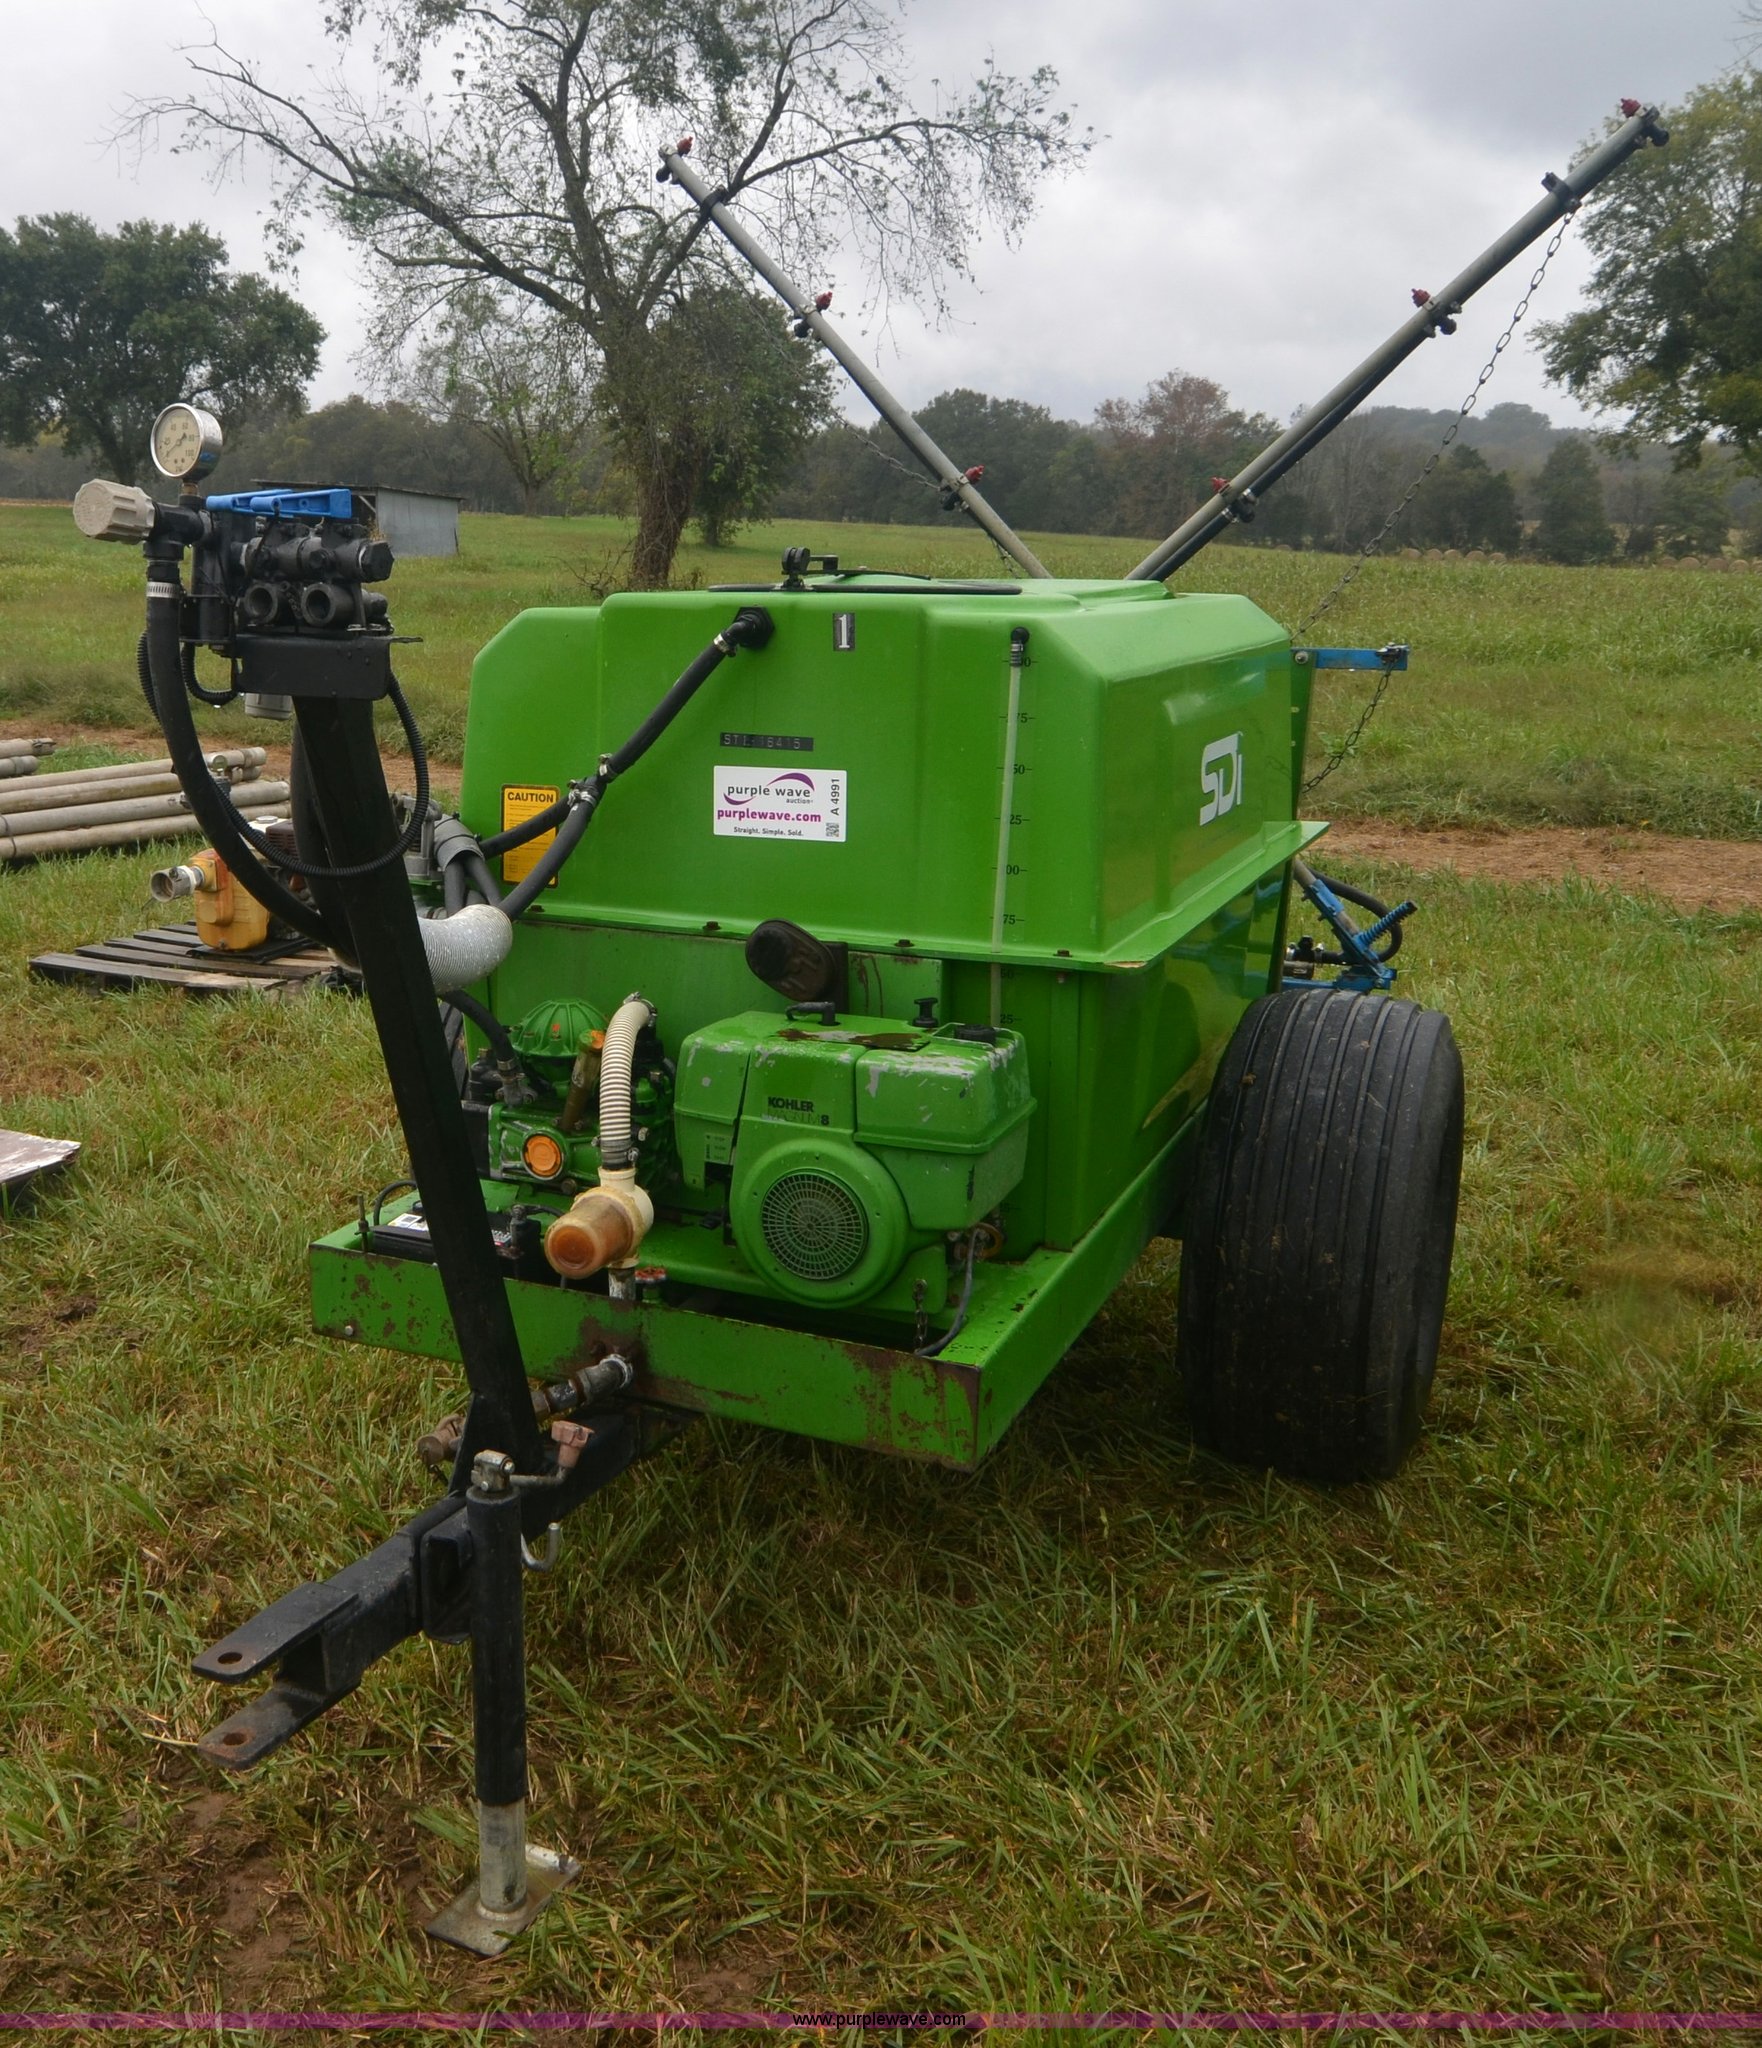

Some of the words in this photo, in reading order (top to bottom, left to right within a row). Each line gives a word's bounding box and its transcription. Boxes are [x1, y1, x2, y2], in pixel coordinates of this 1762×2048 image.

[838, 613, 850, 648] 1
[507, 791, 554, 803] CAUTION
[727, 785, 770, 798] purple
[775, 787, 811, 798] wave
[830, 778, 840, 805] 4991
[717, 807, 822, 823] purplewave.com
[830, 807, 840, 816] A
[733, 826, 760, 835] Straight.
[762, 827, 786, 836] Simple.
[768, 1096, 814, 1112] KOHLER
[820, 1114, 830, 1126] 8
